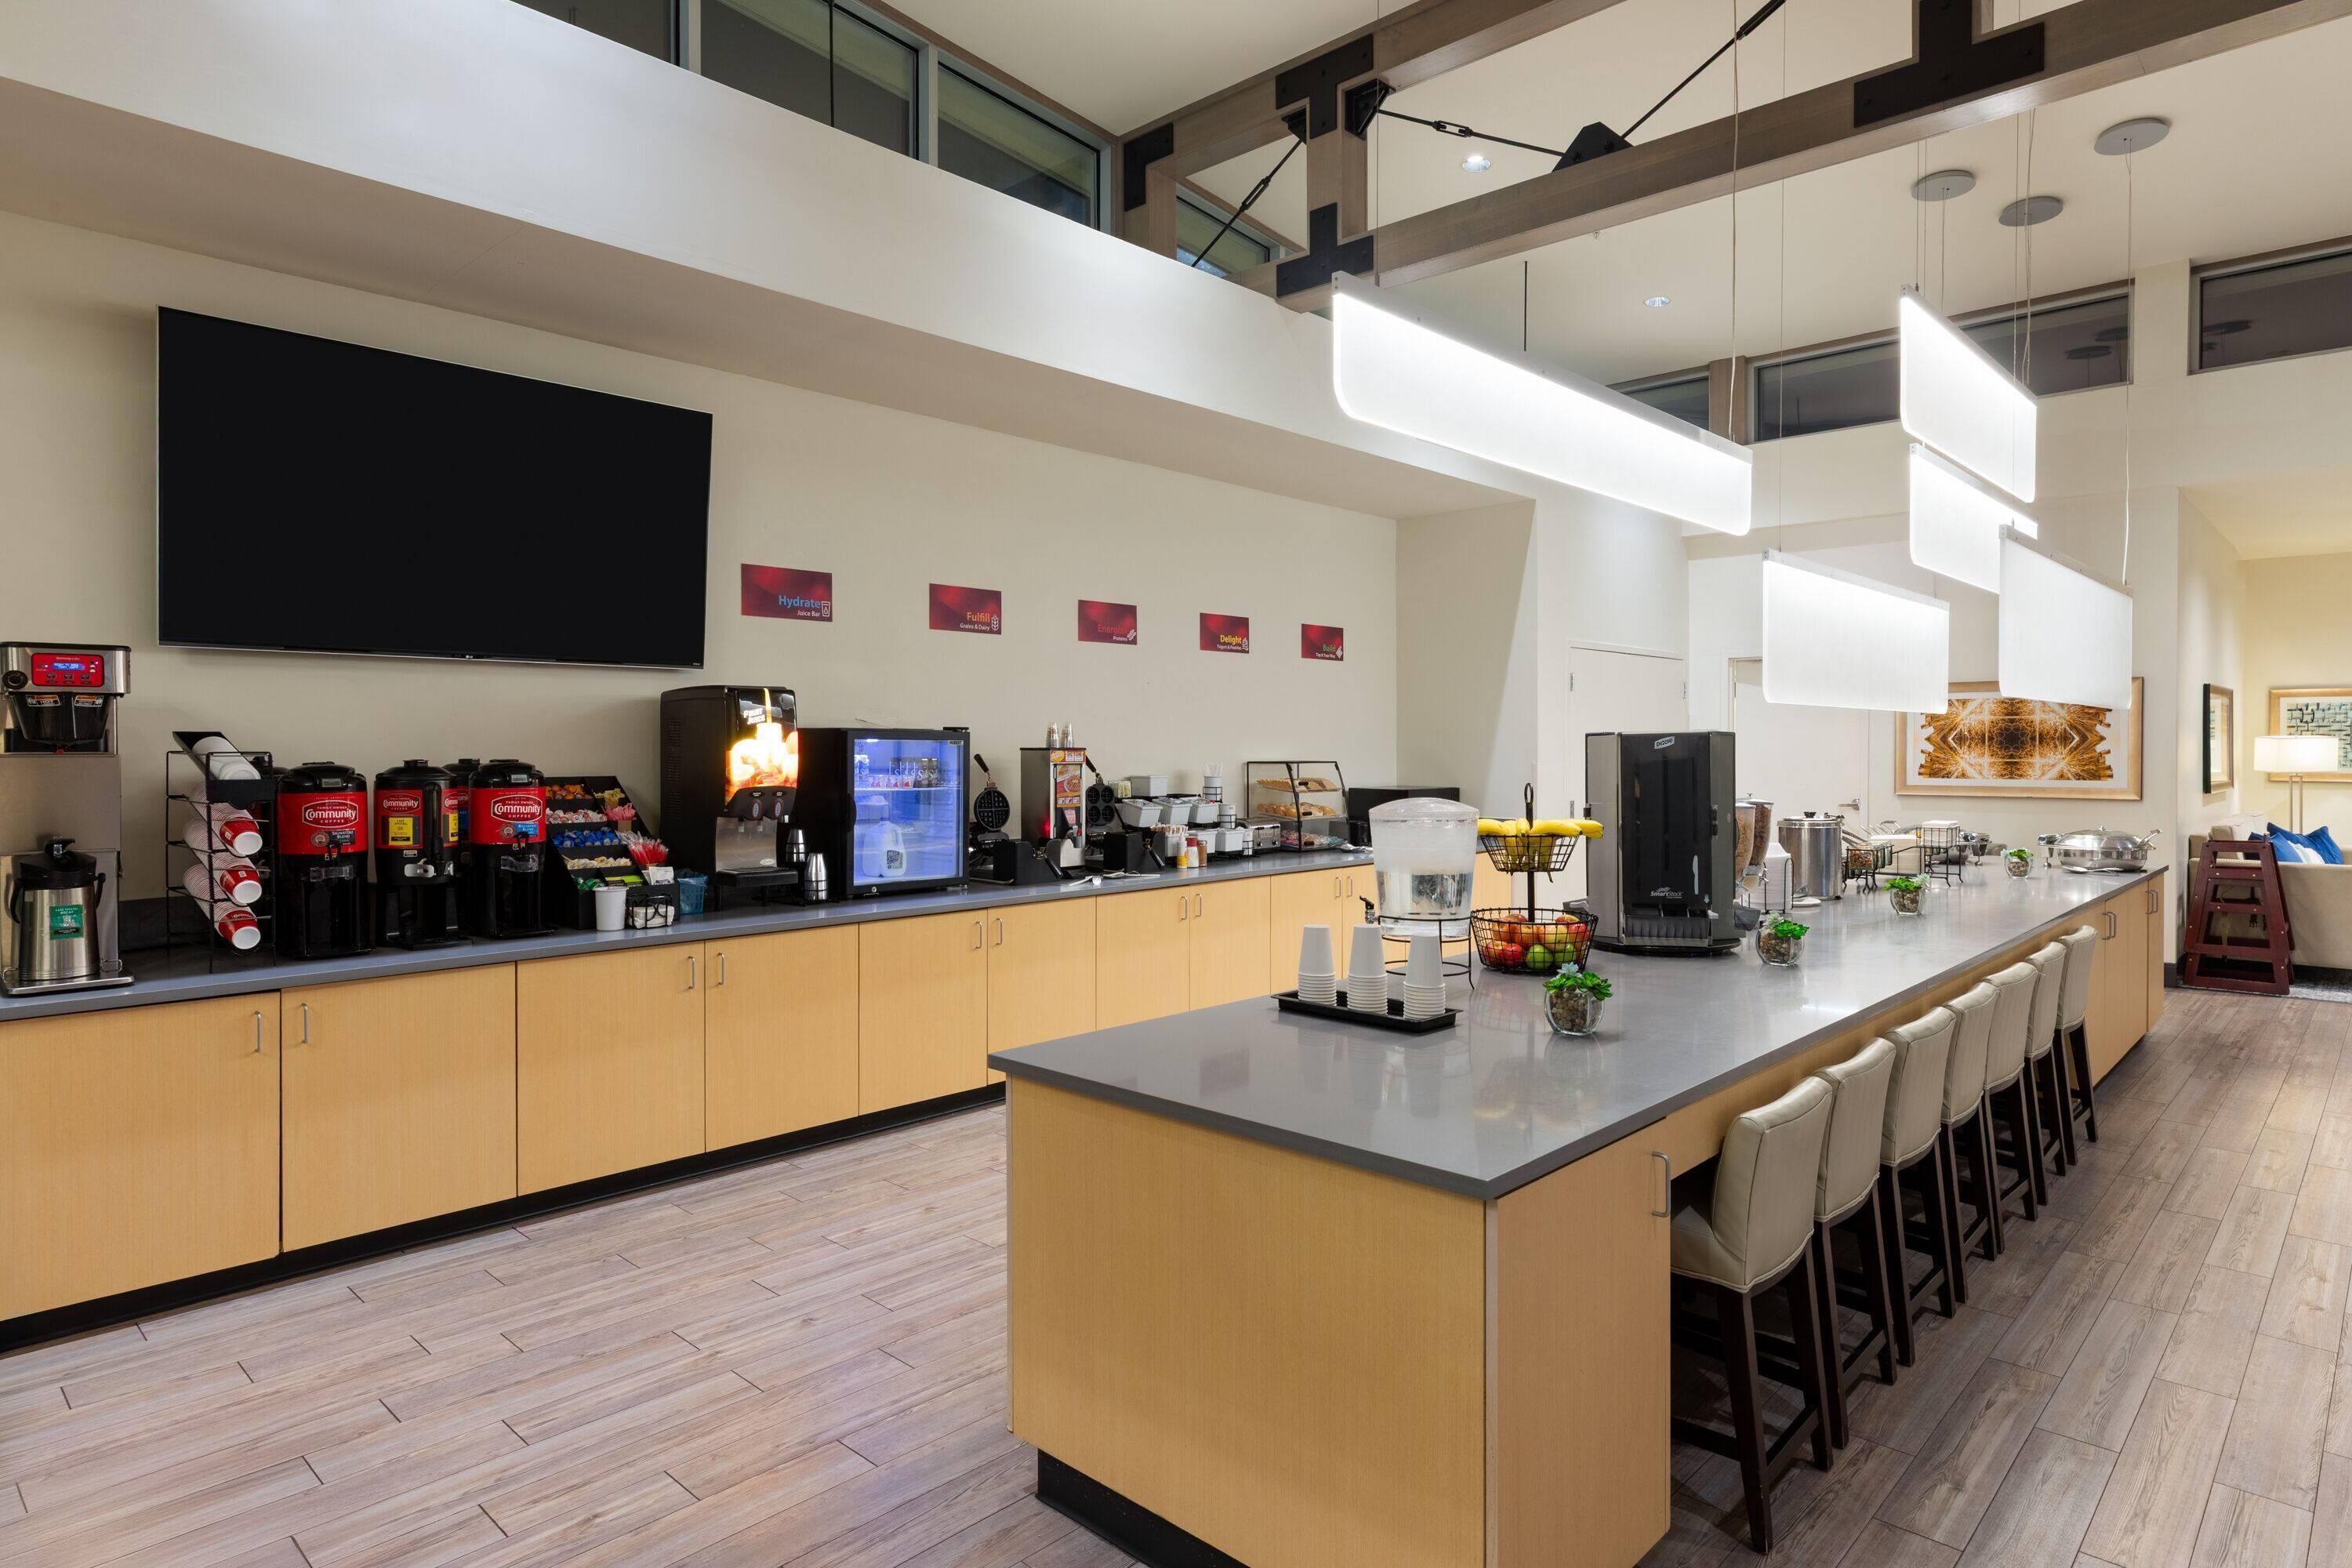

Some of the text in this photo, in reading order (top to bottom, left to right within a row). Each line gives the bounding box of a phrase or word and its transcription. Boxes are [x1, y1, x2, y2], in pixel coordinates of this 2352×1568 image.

[779, 595, 820, 608] Hydrate
[967, 612, 990, 622] Fulfill
[1220, 634, 1242, 645] Delight
[743, 708, 764, 718] FRUIT
[747, 714, 765, 724] JUICE
[929, 769, 938, 780] Sil
[383, 799, 419, 808] Community
[494, 803, 541, 815] Community
[305, 808, 356, 821] Community
